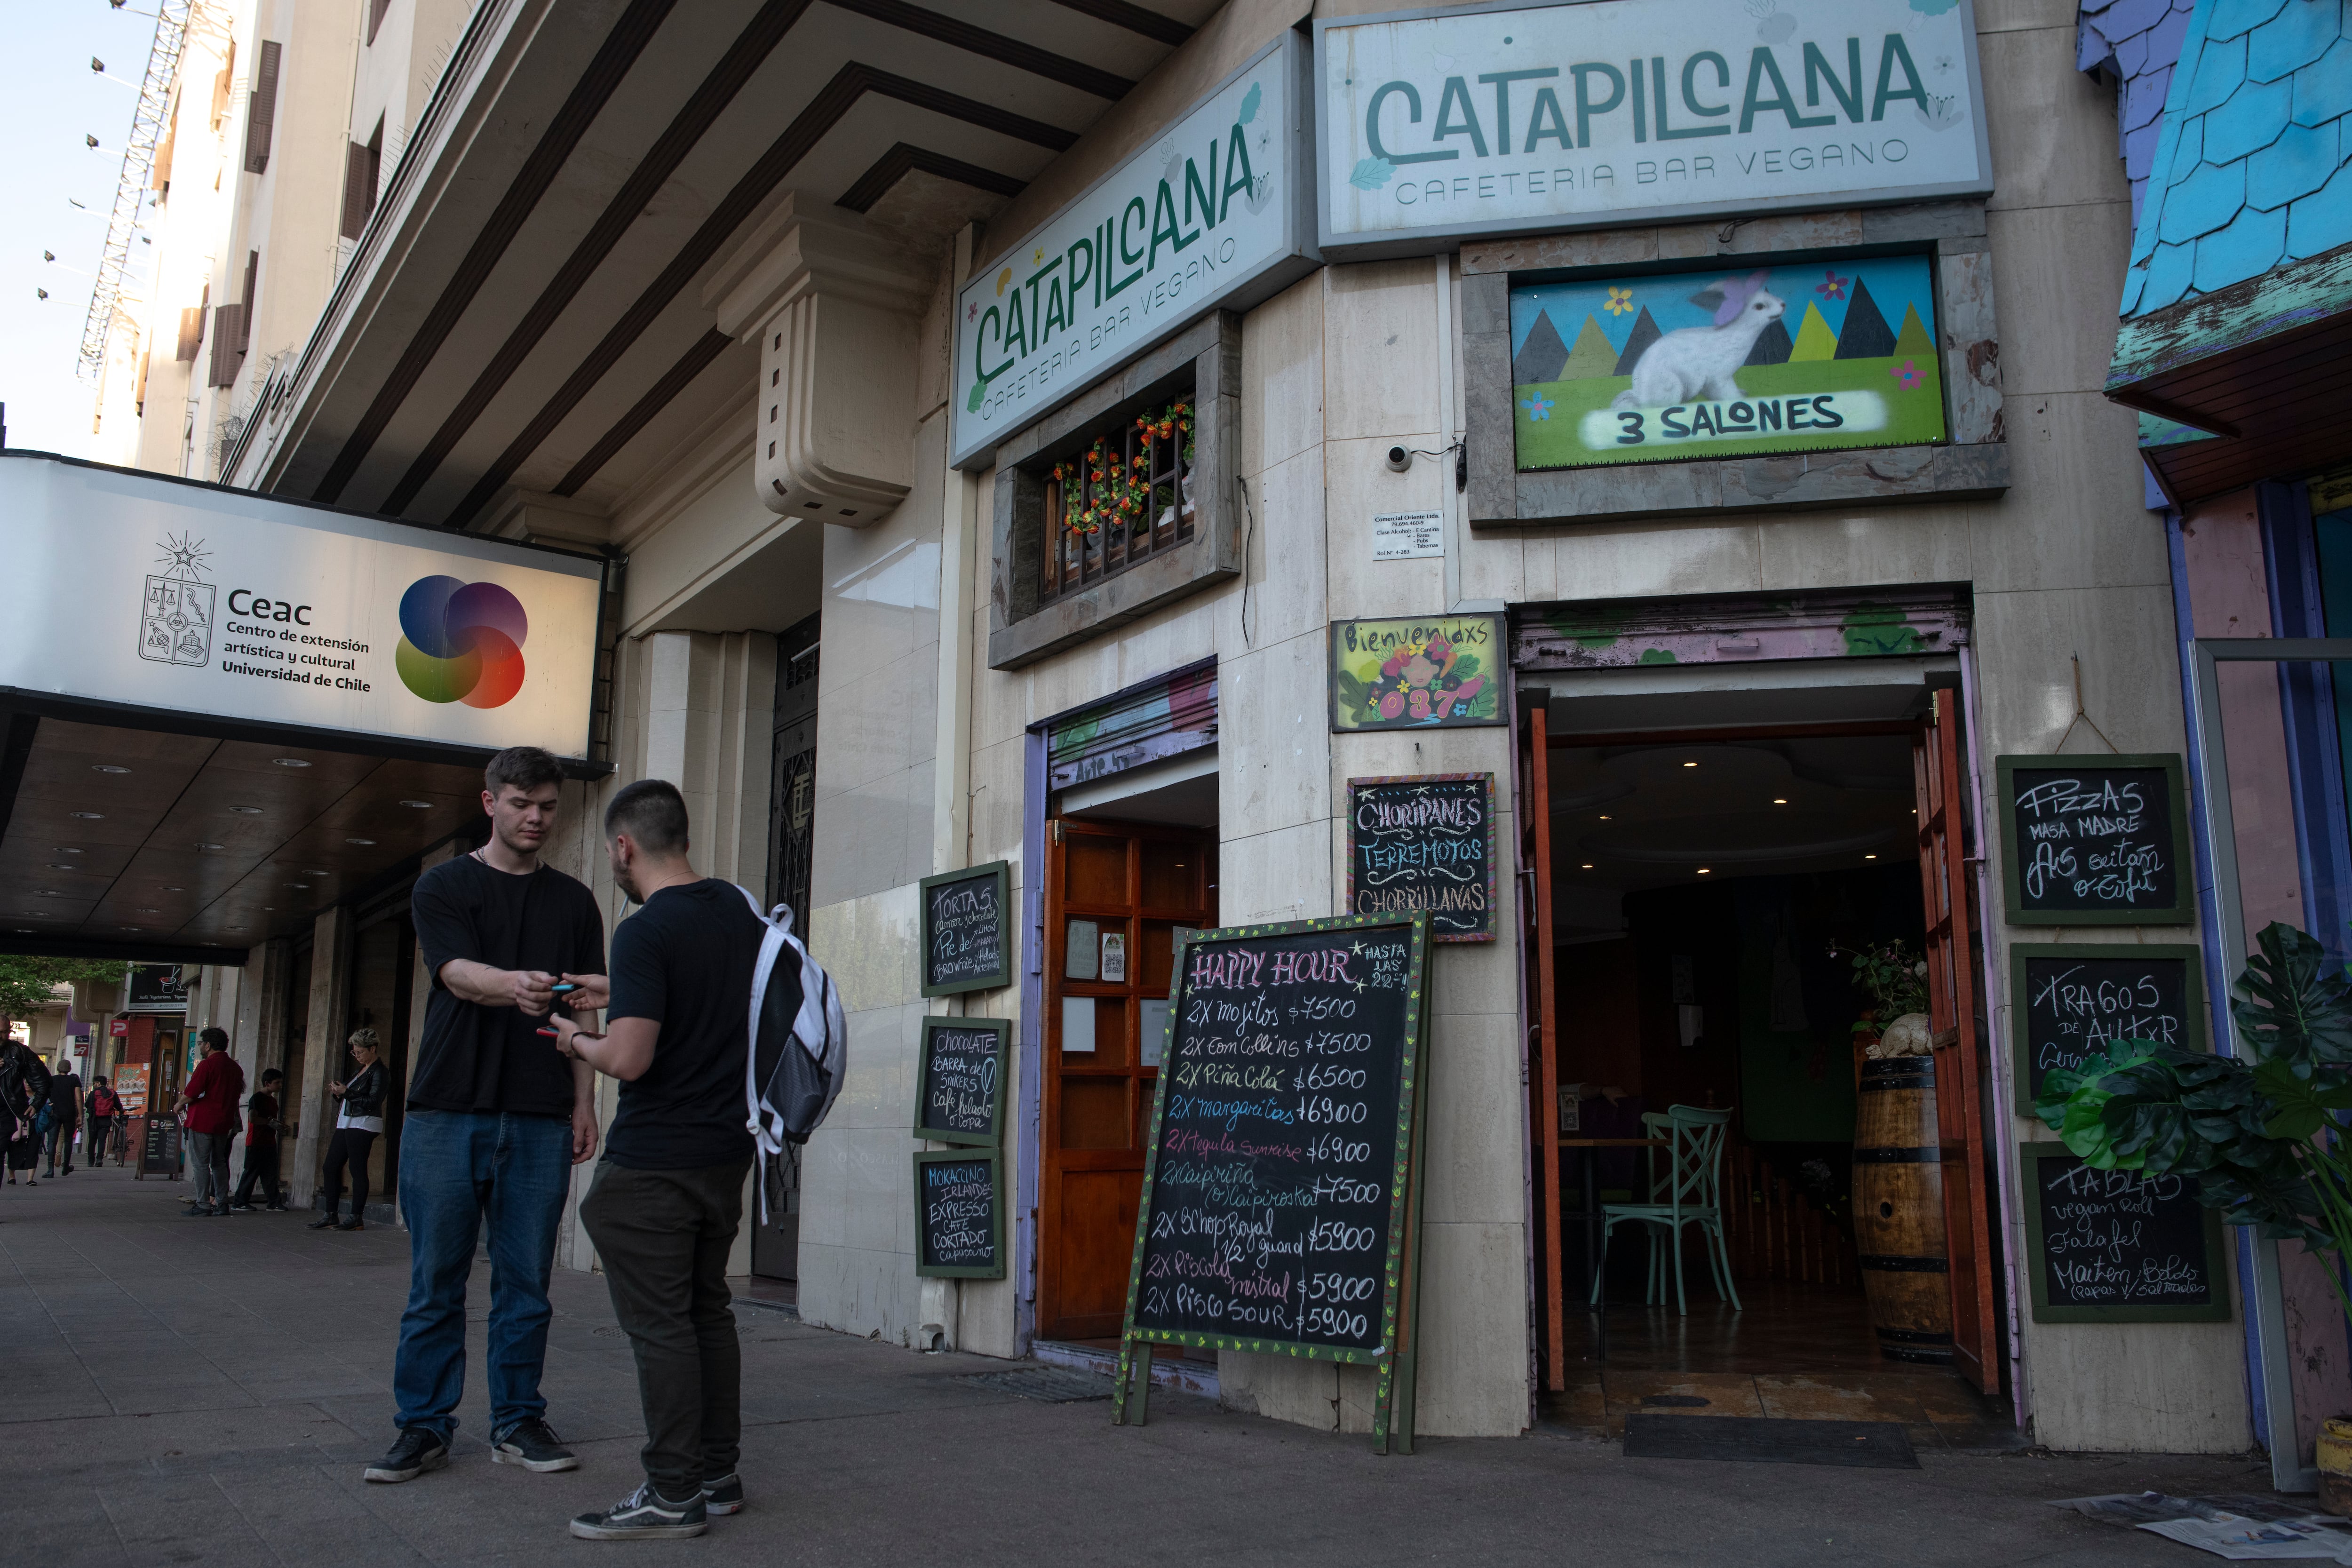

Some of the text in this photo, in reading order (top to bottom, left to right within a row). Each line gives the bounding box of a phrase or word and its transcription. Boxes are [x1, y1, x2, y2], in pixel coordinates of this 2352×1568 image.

[1366, 33, 1931, 164] CATAPILCANA
[1395, 138, 1909, 205] CAFETERIA BAR VEGANO
[976, 122, 1255, 383] CATAPILCANA
[982, 237, 1235, 421] CAFETERIA BAR VEGANO
[1617, 396, 1844, 444] 3 SALONES
[227, 589, 312, 626] Ceac
[227, 621, 370, 653] Centro de extensión
[224, 640, 355, 671] artística y cultural
[222, 661, 371, 692] Universidad de Chile
[1380, 689, 1459, 719] 037
[2029, 814, 2140, 840] MASA MADRE
[1358, 837, 1482, 870] TERREMOTOS
[932, 885, 991, 920] TORTAS
[933, 930, 971, 959] Pie de
[1365, 943, 1406, 960] HASTA
[1191, 947, 1358, 990] HAPPY HOUR
[1374, 959, 1402, 972] LAS
[2033, 964, 2160, 1017] TRAGOS
[1288, 996, 1357, 1024] $7500
[1305, 1031, 1371, 1055] $7500
[2058, 1022, 2080, 1035] DE
[931, 1056, 968, 1073] BARRA
[970, 1061, 982, 1075] de
[1293, 1062, 1367, 1092] $6500
[1296, 1096, 1367, 1123] $6900
[1306, 1132, 1371, 1164] $6900
[929, 1165, 985, 1186] MOKACCINO
[1312, 1173, 1380, 1203] $7500
[929, 1201, 988, 1225] EXPRESSO
[933, 1229, 987, 1249] CORTADO
[1308, 1216, 1375, 1252] $5900
[1296, 1268, 1375, 1305] $5900
[1296, 1304, 1368, 1339] $5900
